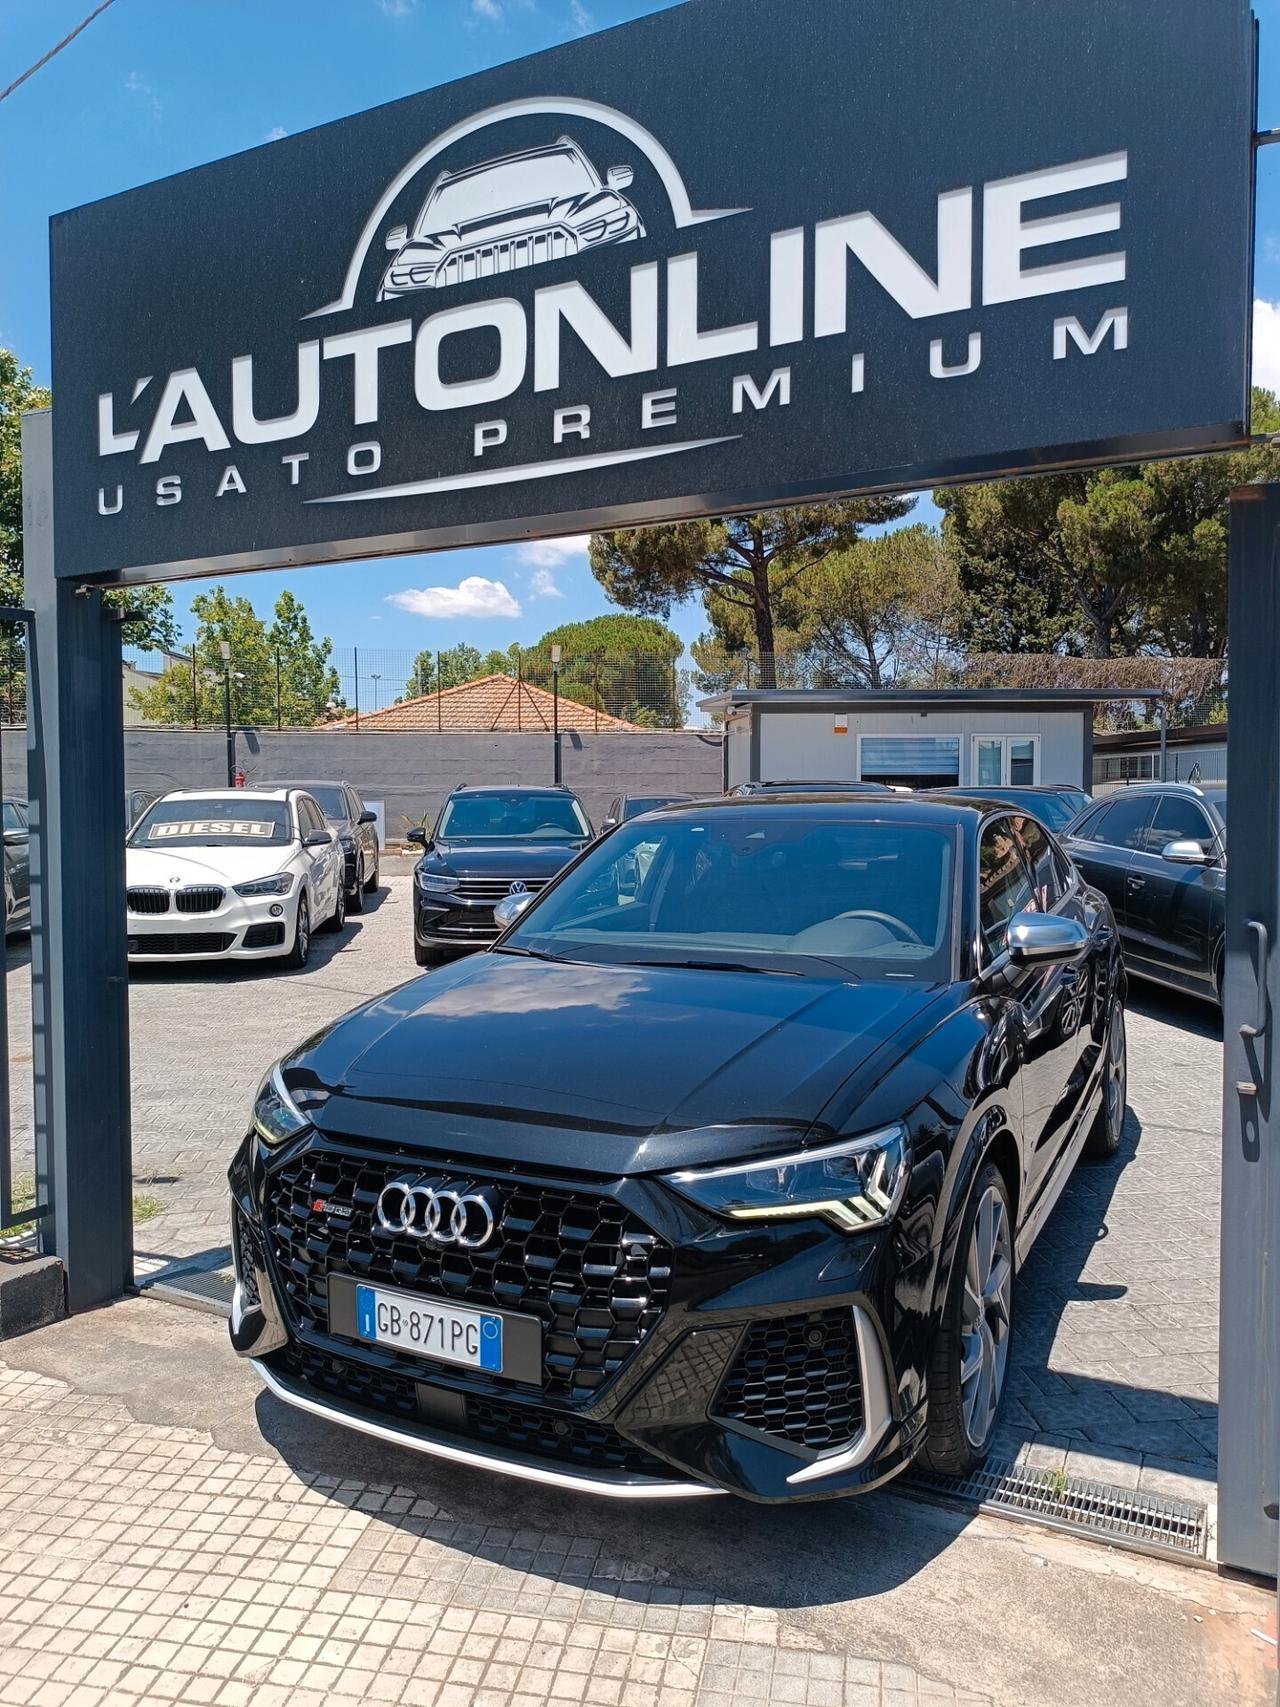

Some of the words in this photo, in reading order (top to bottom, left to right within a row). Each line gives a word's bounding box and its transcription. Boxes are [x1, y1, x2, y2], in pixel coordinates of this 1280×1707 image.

[98, 441, 382, 516] USATO
[473, 306, 1128, 457] PREMIUM
[99, 150, 1128, 464] L'AUTONLINE
[156, 822, 265, 836] DIESEL
